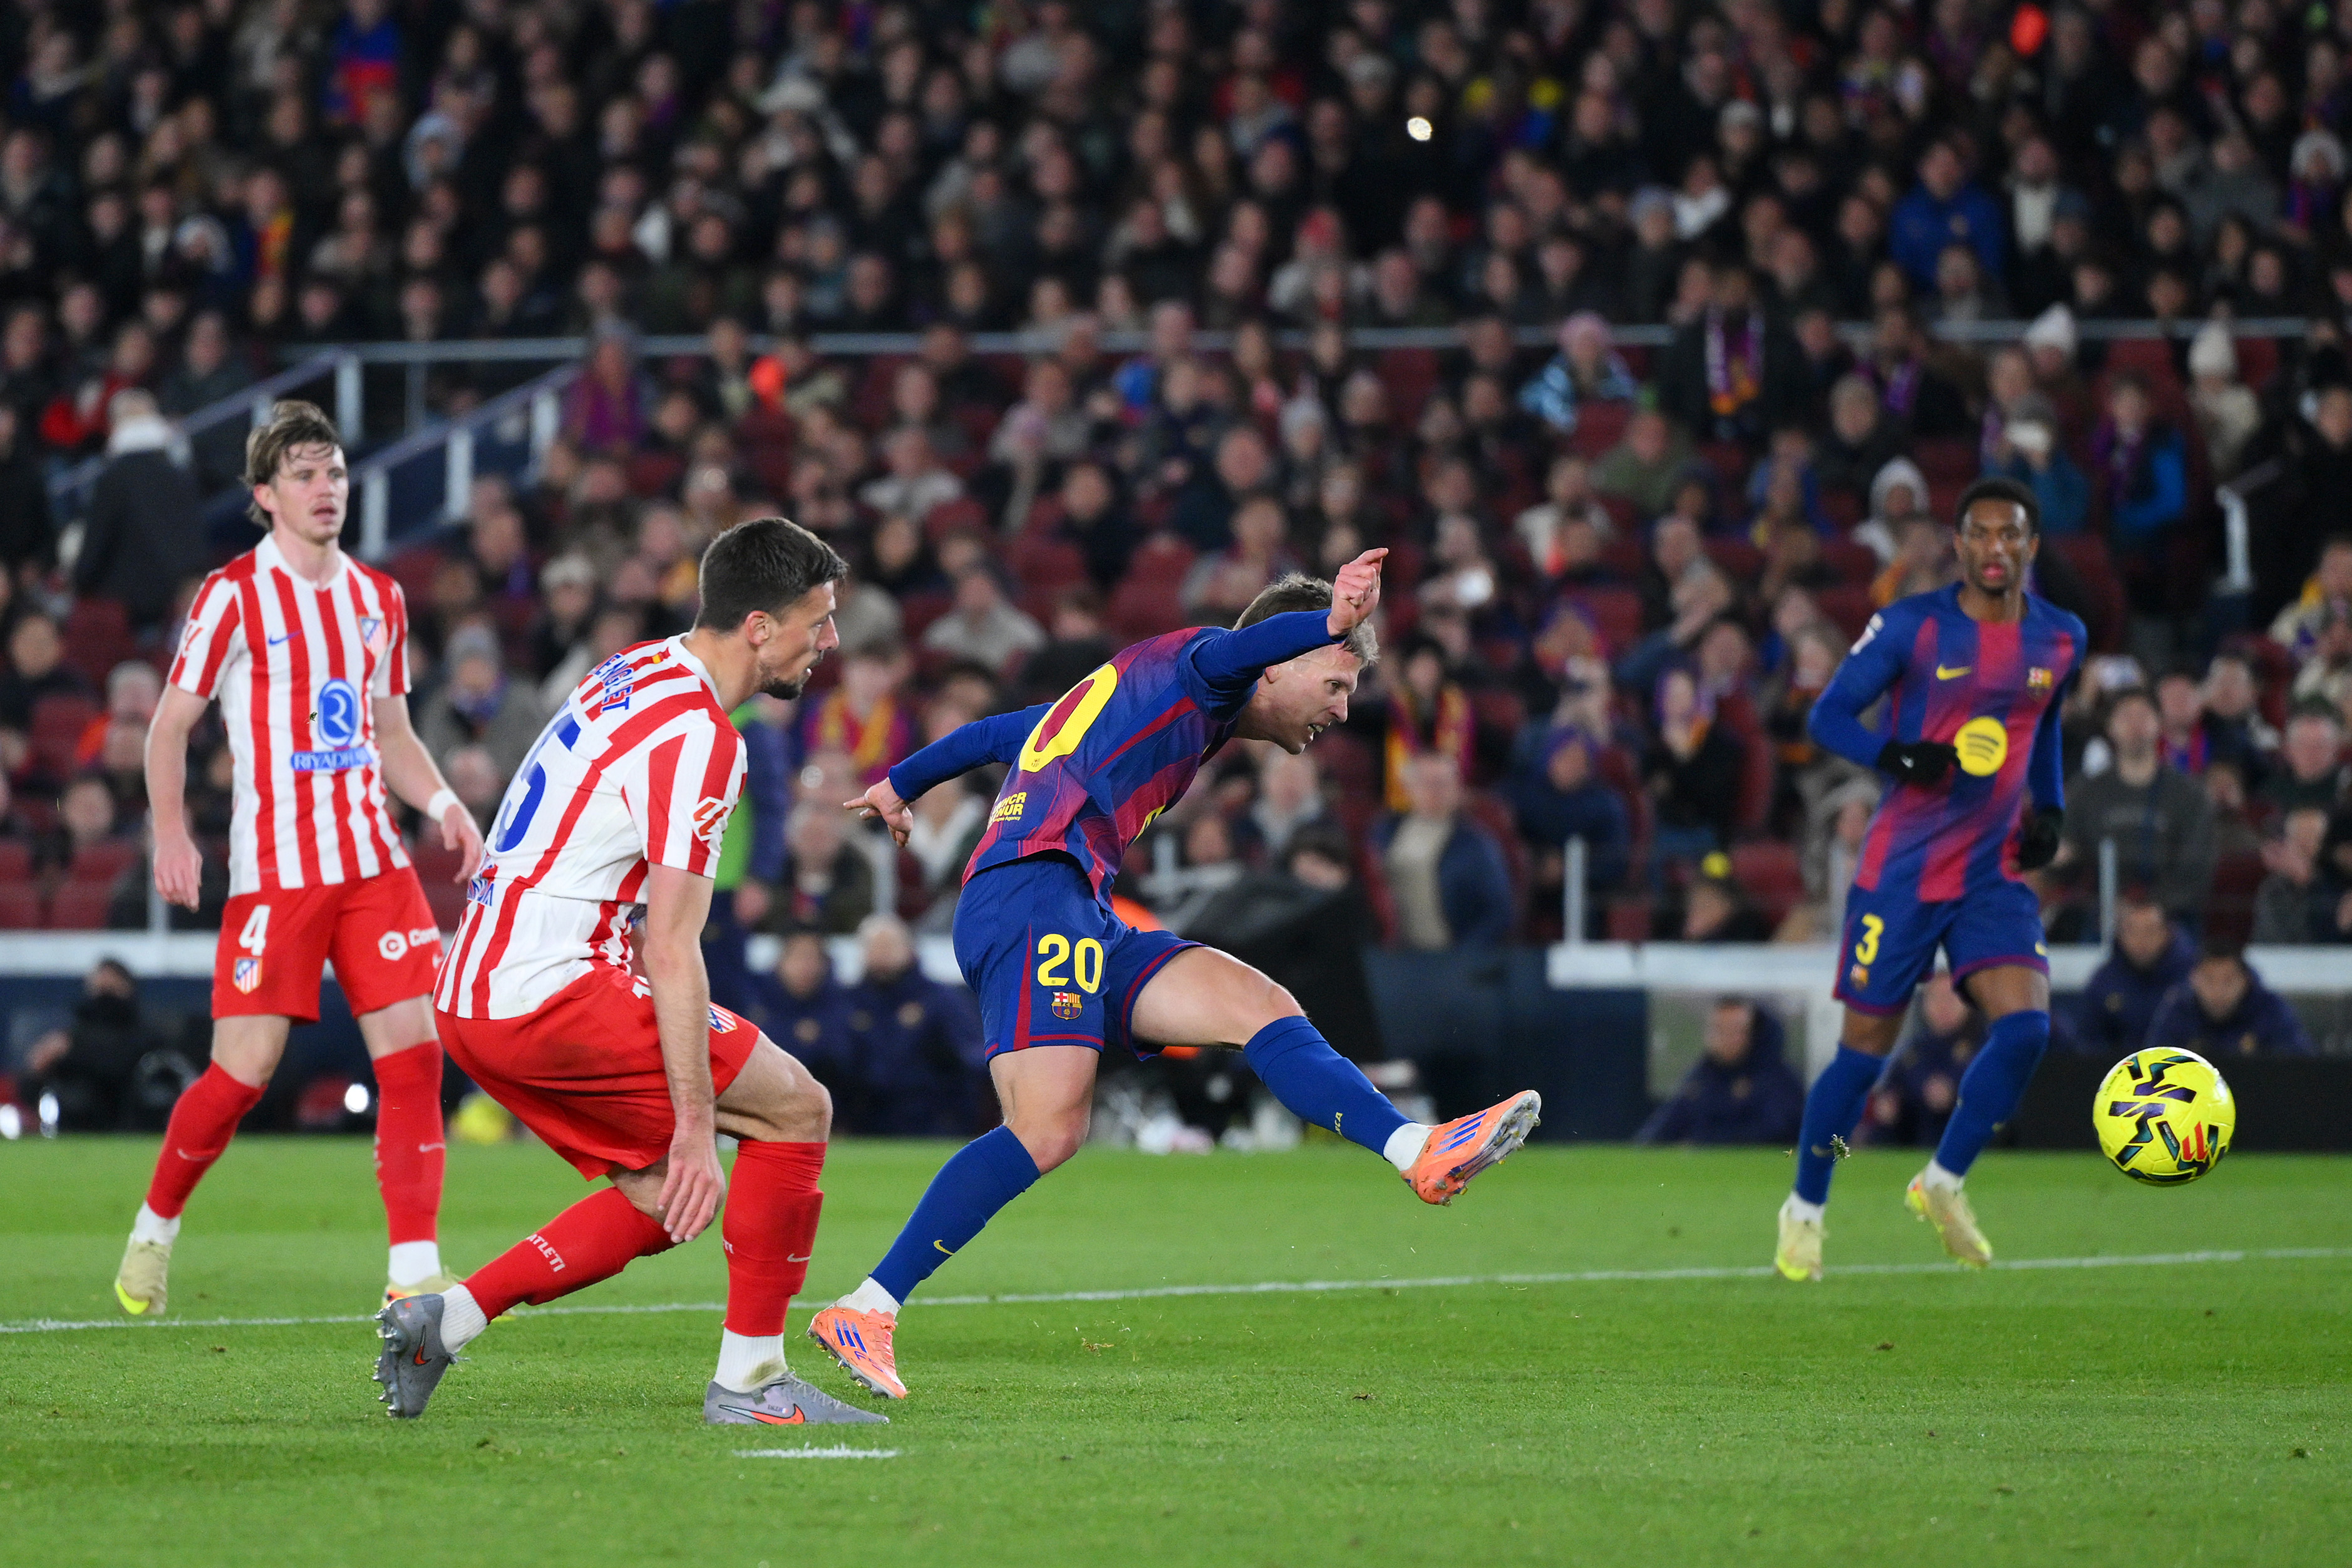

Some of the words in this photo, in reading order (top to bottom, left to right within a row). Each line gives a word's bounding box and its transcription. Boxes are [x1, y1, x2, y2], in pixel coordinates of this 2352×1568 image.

[589, 654, 633, 712] ENGLET
[1019, 663, 1118, 772] 0
[495, 700, 582, 852] 5
[239, 904, 271, 956] 4
[1855, 913, 1884, 965] 3
[1038, 934, 1103, 994] 20
[526, 1234, 565, 1272] ATLETI
